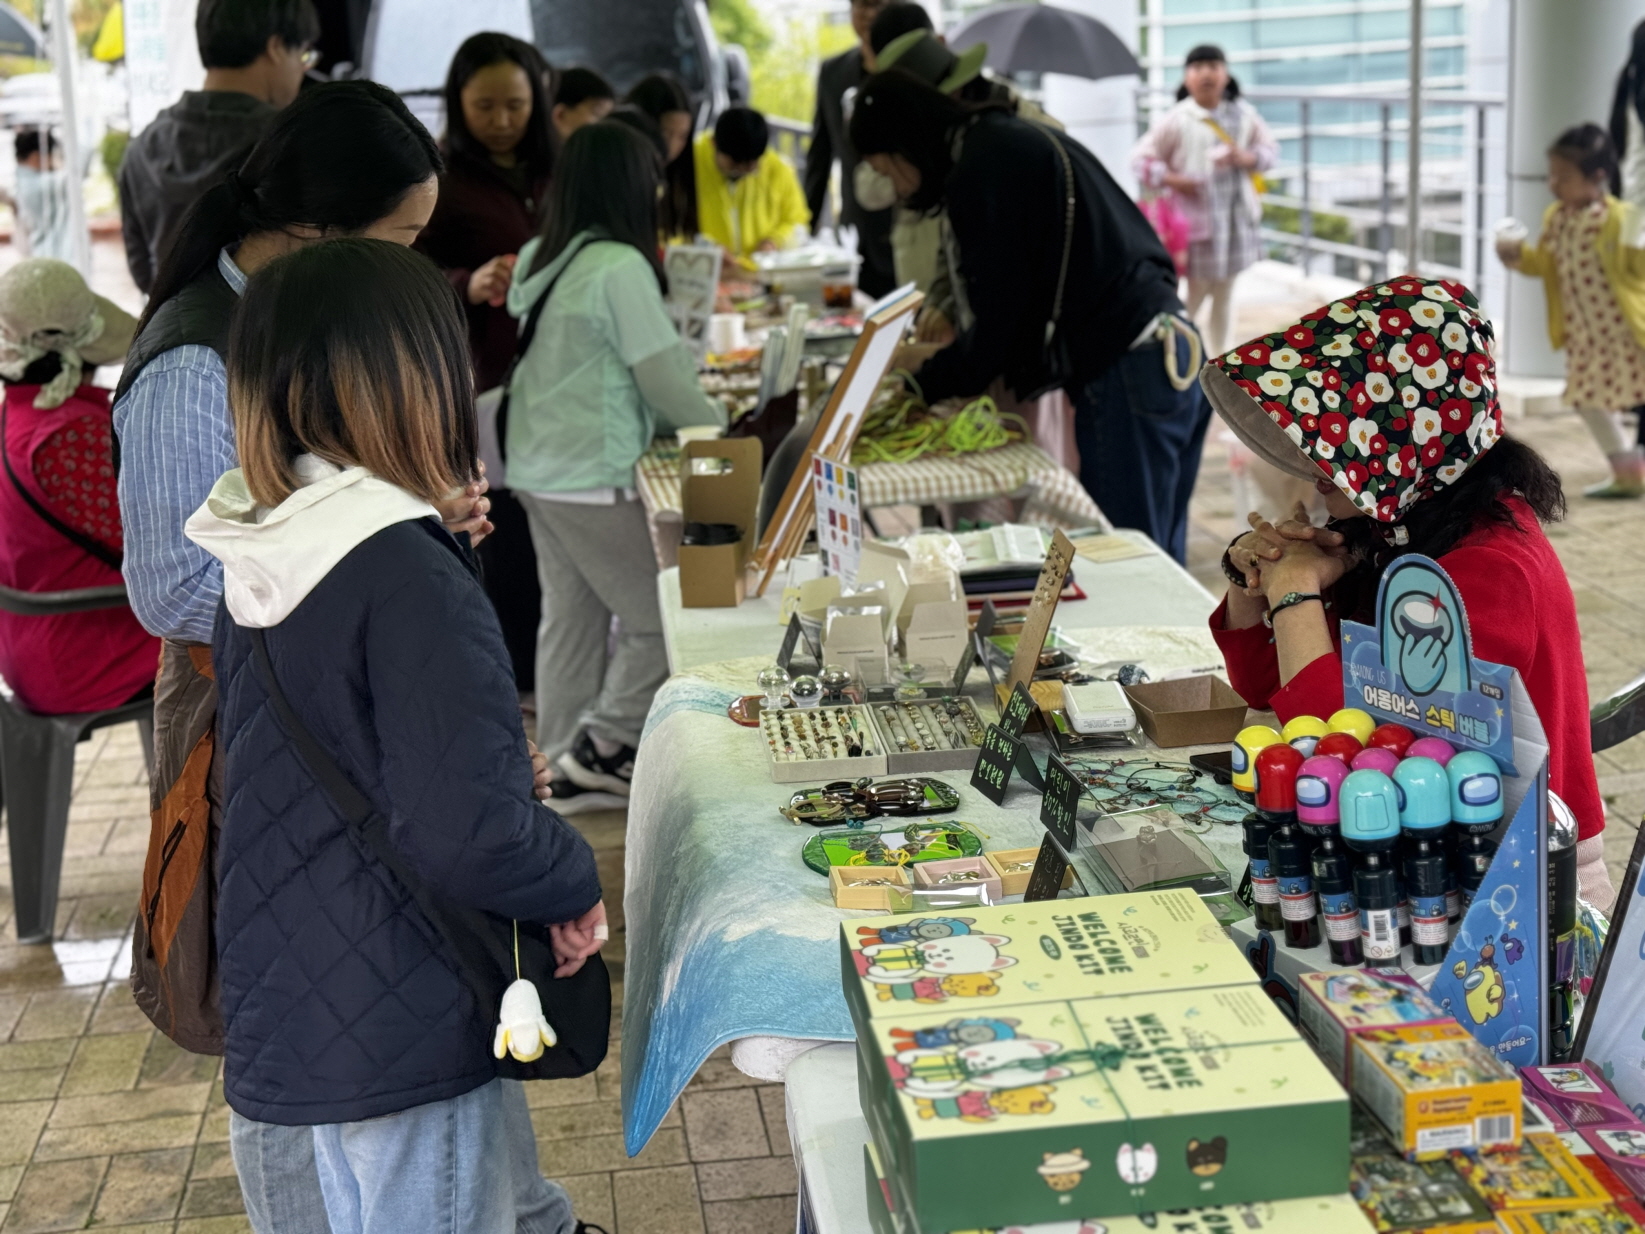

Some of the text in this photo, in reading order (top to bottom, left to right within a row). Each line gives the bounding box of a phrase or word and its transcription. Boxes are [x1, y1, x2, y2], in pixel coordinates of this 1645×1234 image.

[1377, 669, 1386, 685] US
[1363, 685, 1491, 745] 어몽어스 스틱 버블
[1050, 767, 1071, 802] 어린이
[1051, 915, 1090, 951] JINDO
[1073, 954, 1105, 976] KIT
[1077, 911, 1134, 974] WELCOME
[1106, 1016, 1172, 1090] JINDO KIT
[1134, 1012, 1203, 1088] WELCOME
